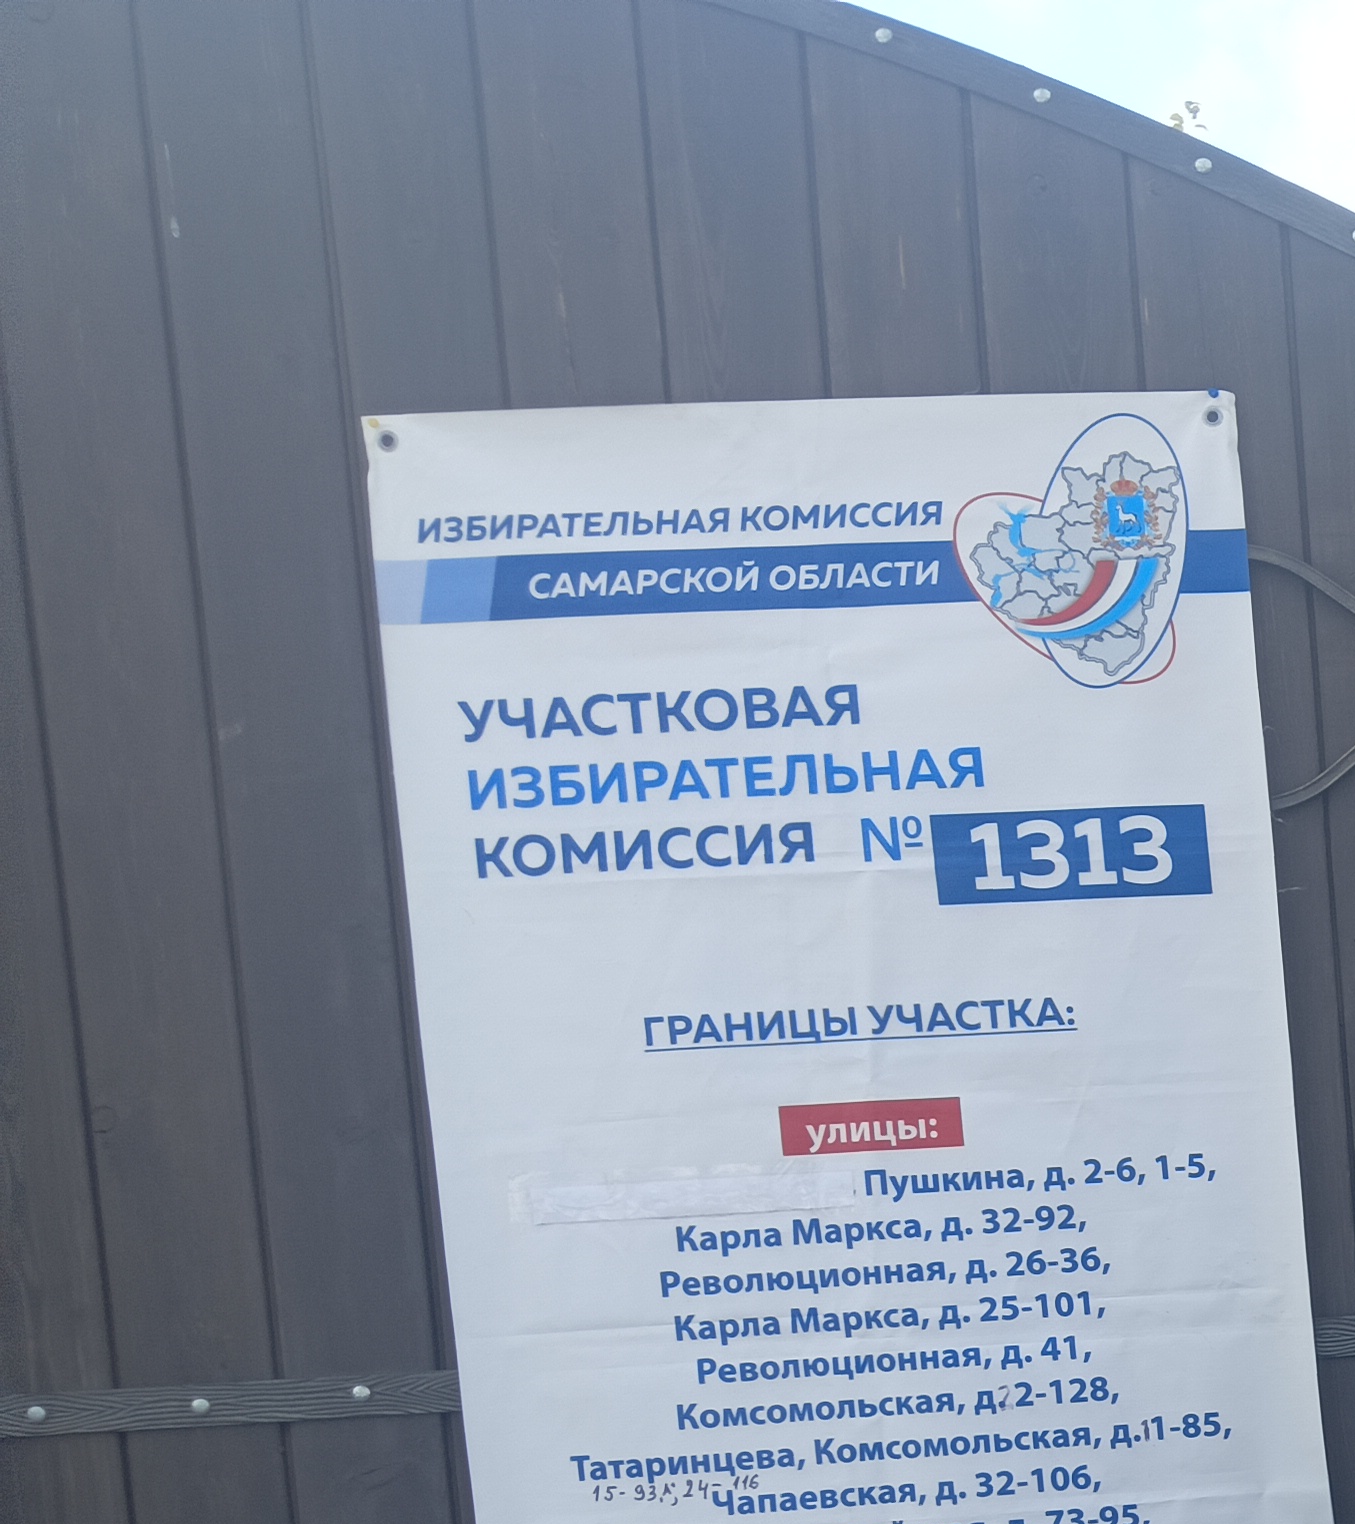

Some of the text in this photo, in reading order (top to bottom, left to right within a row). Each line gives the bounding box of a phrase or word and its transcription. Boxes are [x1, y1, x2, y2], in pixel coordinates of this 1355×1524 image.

[417, 500, 944, 544] ИЗБИРАТЕЛЬНАЯ КОМИССИЯ
[528, 559, 940, 599] САМАРСКОЙ ОБЛАСТИ
[457, 684, 862, 743] УЧАСТКОВАЯ
[467, 746, 986, 811] ИЗБИРАТЕЛЬНАЯ
[474, 814, 1175, 891] КОМИССИЯ № 1313
[643, 997, 1077, 1048] ГРАНИЦЫ УЧАСТКА:
[805, 1118, 939, 1154] улицы:
[863, 1152, 1217, 1203] Пушкина, д. 2-6, 1-5,
[675, 1203, 1087, 1258] Карла Маркса, д. 32-92,
[659, 1246, 1111, 1299] Революционная, д. 26-36,
[673, 1290, 1106, 1347] Карла Маркса, д. 25-101,
[696, 1335, 1092, 1385] Революционная, д. 41,
[676, 1392, 966, 1431] Комсомольская,
[569, 1448, 806, 1485] Татаринцева,
[813, 1426, 1102, 1466] Комсомольская,
[711, 1464, 1102, 1516] Чапаевская, д. 32-106,
